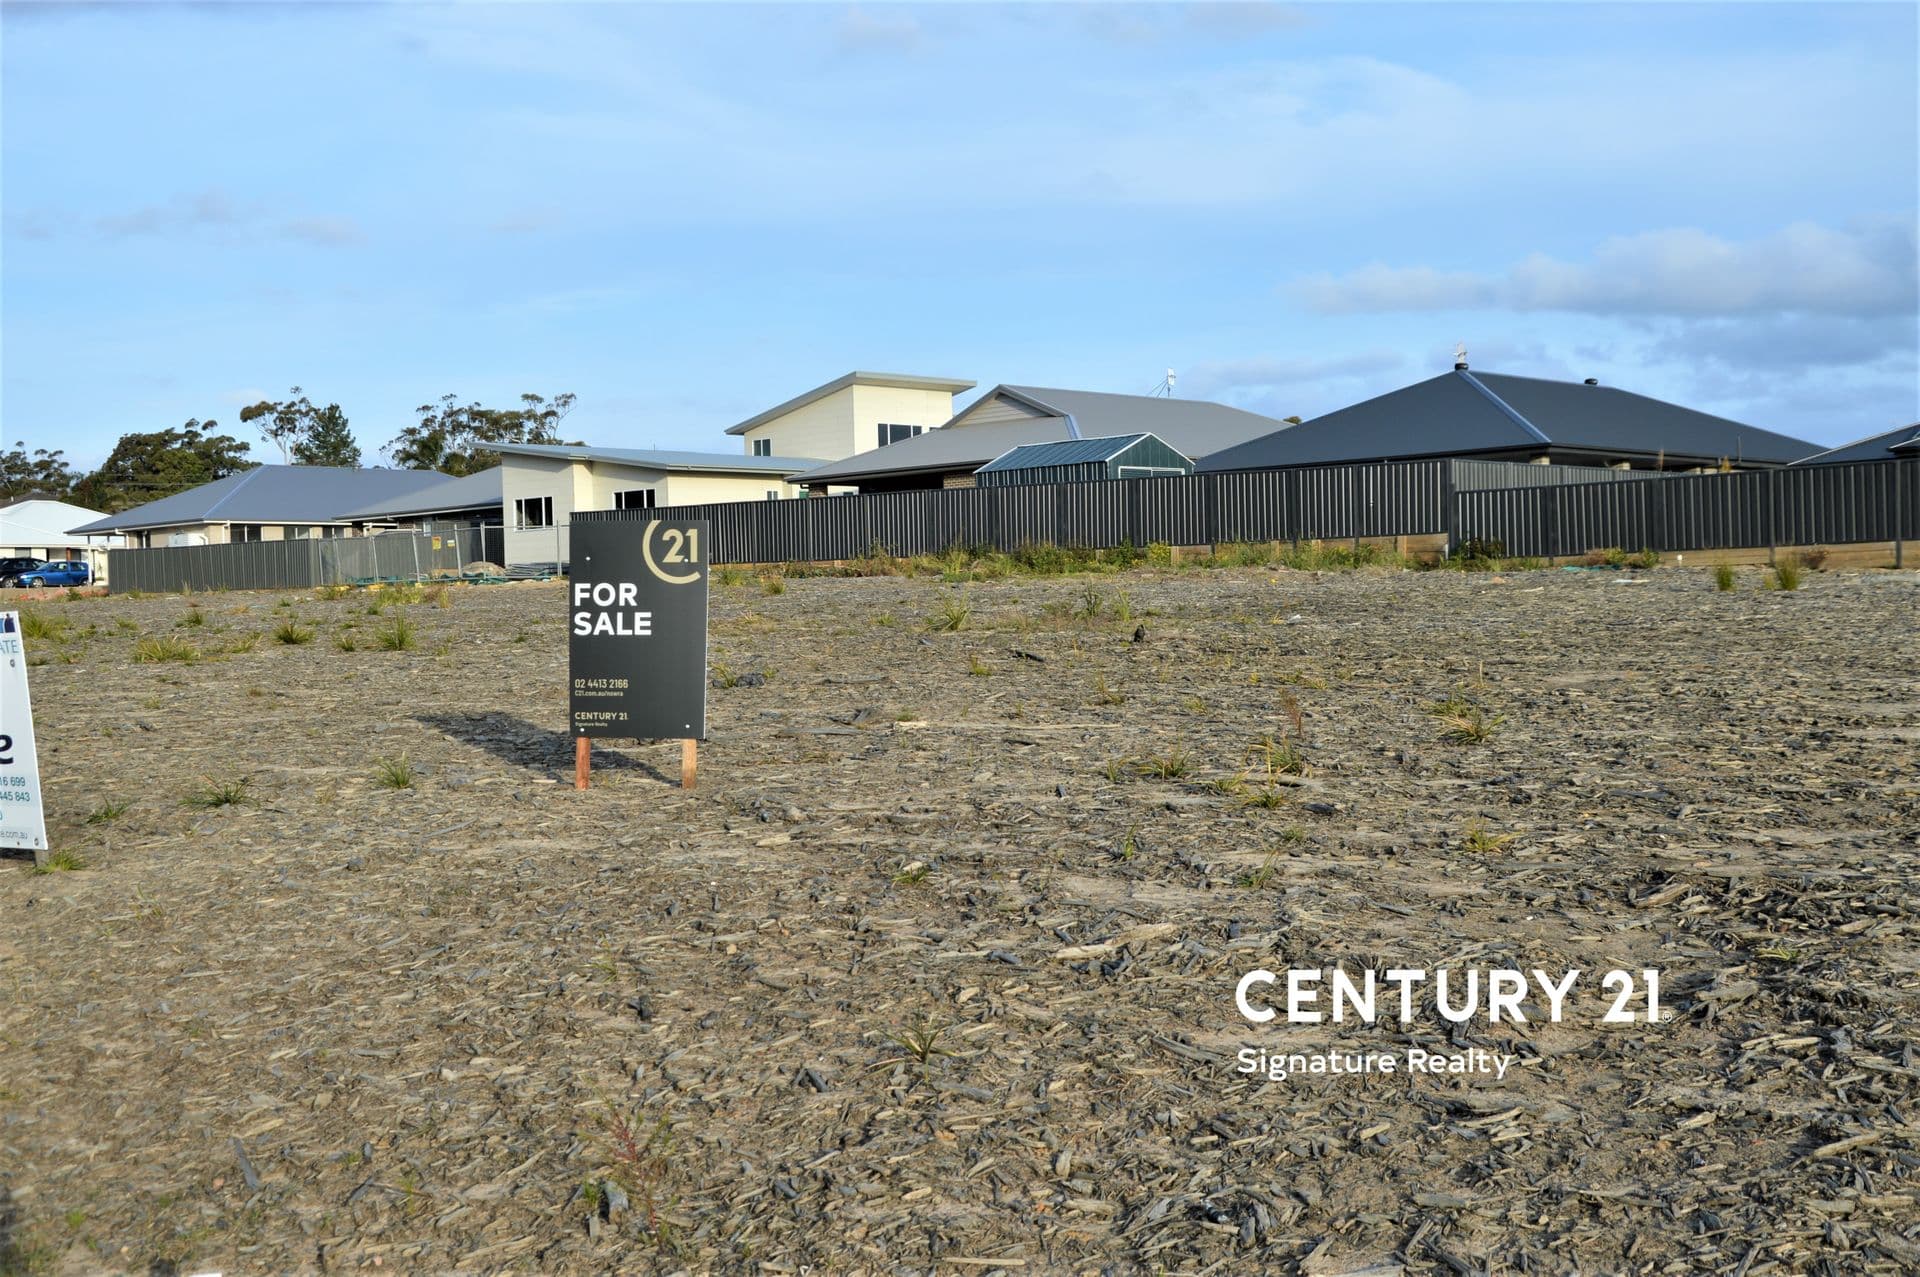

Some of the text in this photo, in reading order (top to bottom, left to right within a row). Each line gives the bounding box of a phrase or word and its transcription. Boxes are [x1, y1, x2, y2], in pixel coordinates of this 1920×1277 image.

[574, 582, 638, 607] FOR
[573, 611, 653, 636] SALE
[574, 678, 629, 689] 02 4413 2166
[574, 711, 628, 721] CENTURY 21
